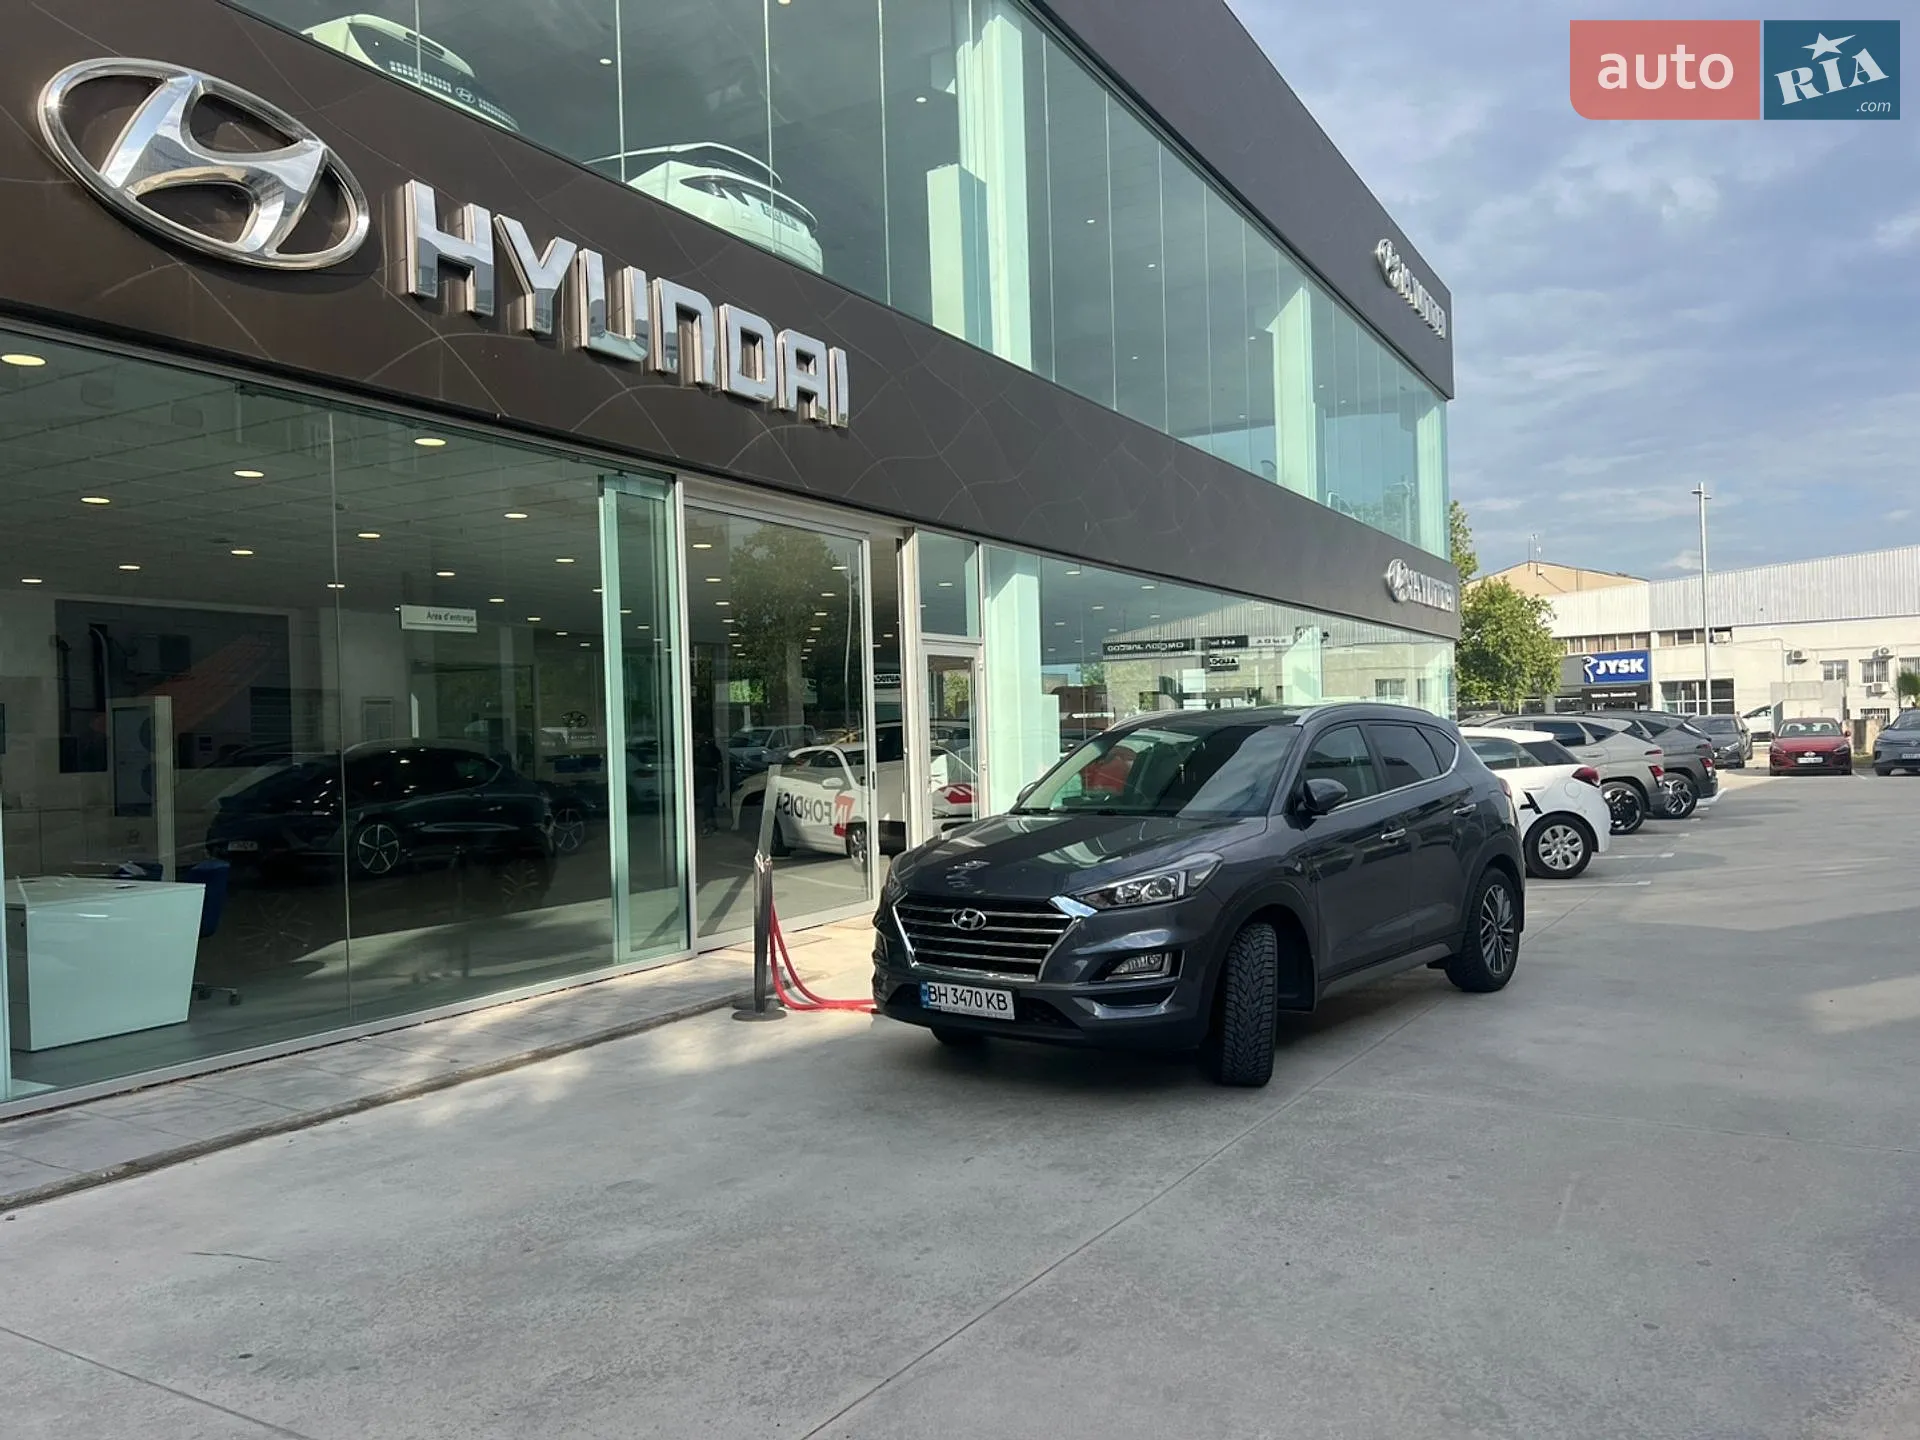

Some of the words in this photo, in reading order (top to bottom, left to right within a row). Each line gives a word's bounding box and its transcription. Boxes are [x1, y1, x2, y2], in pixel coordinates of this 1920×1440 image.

[405, 179, 850, 428] HYUNDAI
[1596, 658, 1645, 675] JYSK
[928, 985, 948, 1004] BH
[951, 987, 983, 1008] 3470
[985, 991, 1008, 1011] KB
